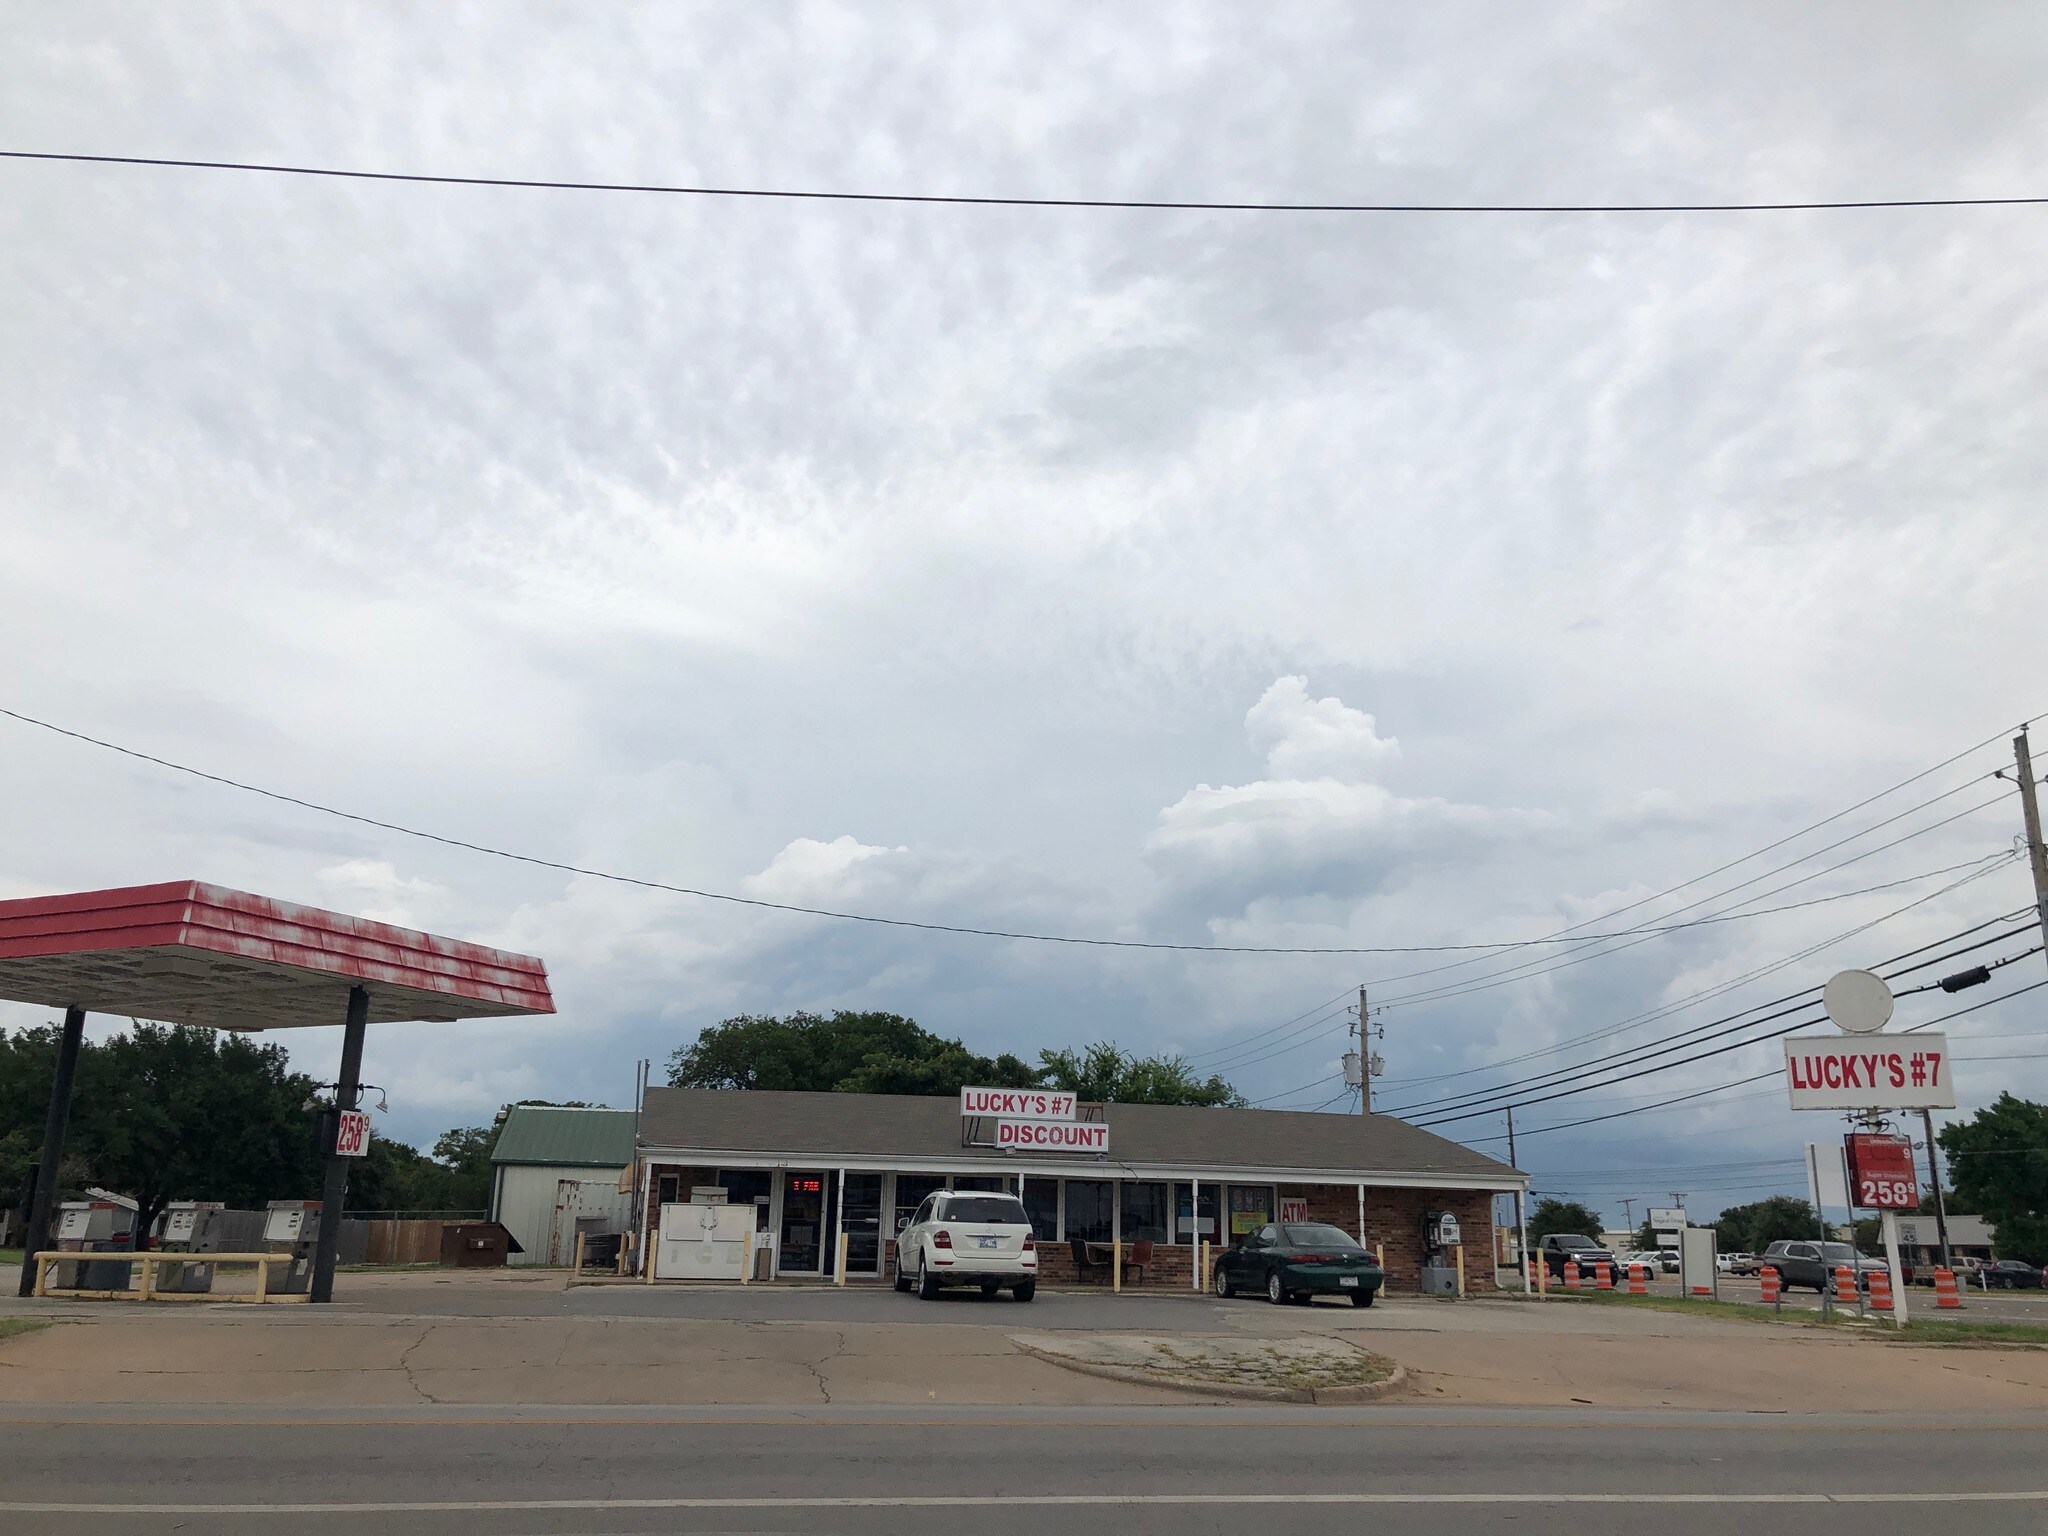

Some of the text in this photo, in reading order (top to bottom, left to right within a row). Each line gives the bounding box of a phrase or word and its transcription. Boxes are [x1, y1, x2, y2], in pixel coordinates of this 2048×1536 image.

[1790, 1052, 1941, 1089] LUCKY'S #7
[965, 1092, 1073, 1115] LUCKY'S #7
[999, 1124, 1107, 1147] DISCOUNT
[1282, 1202, 1307, 1222] ATM
